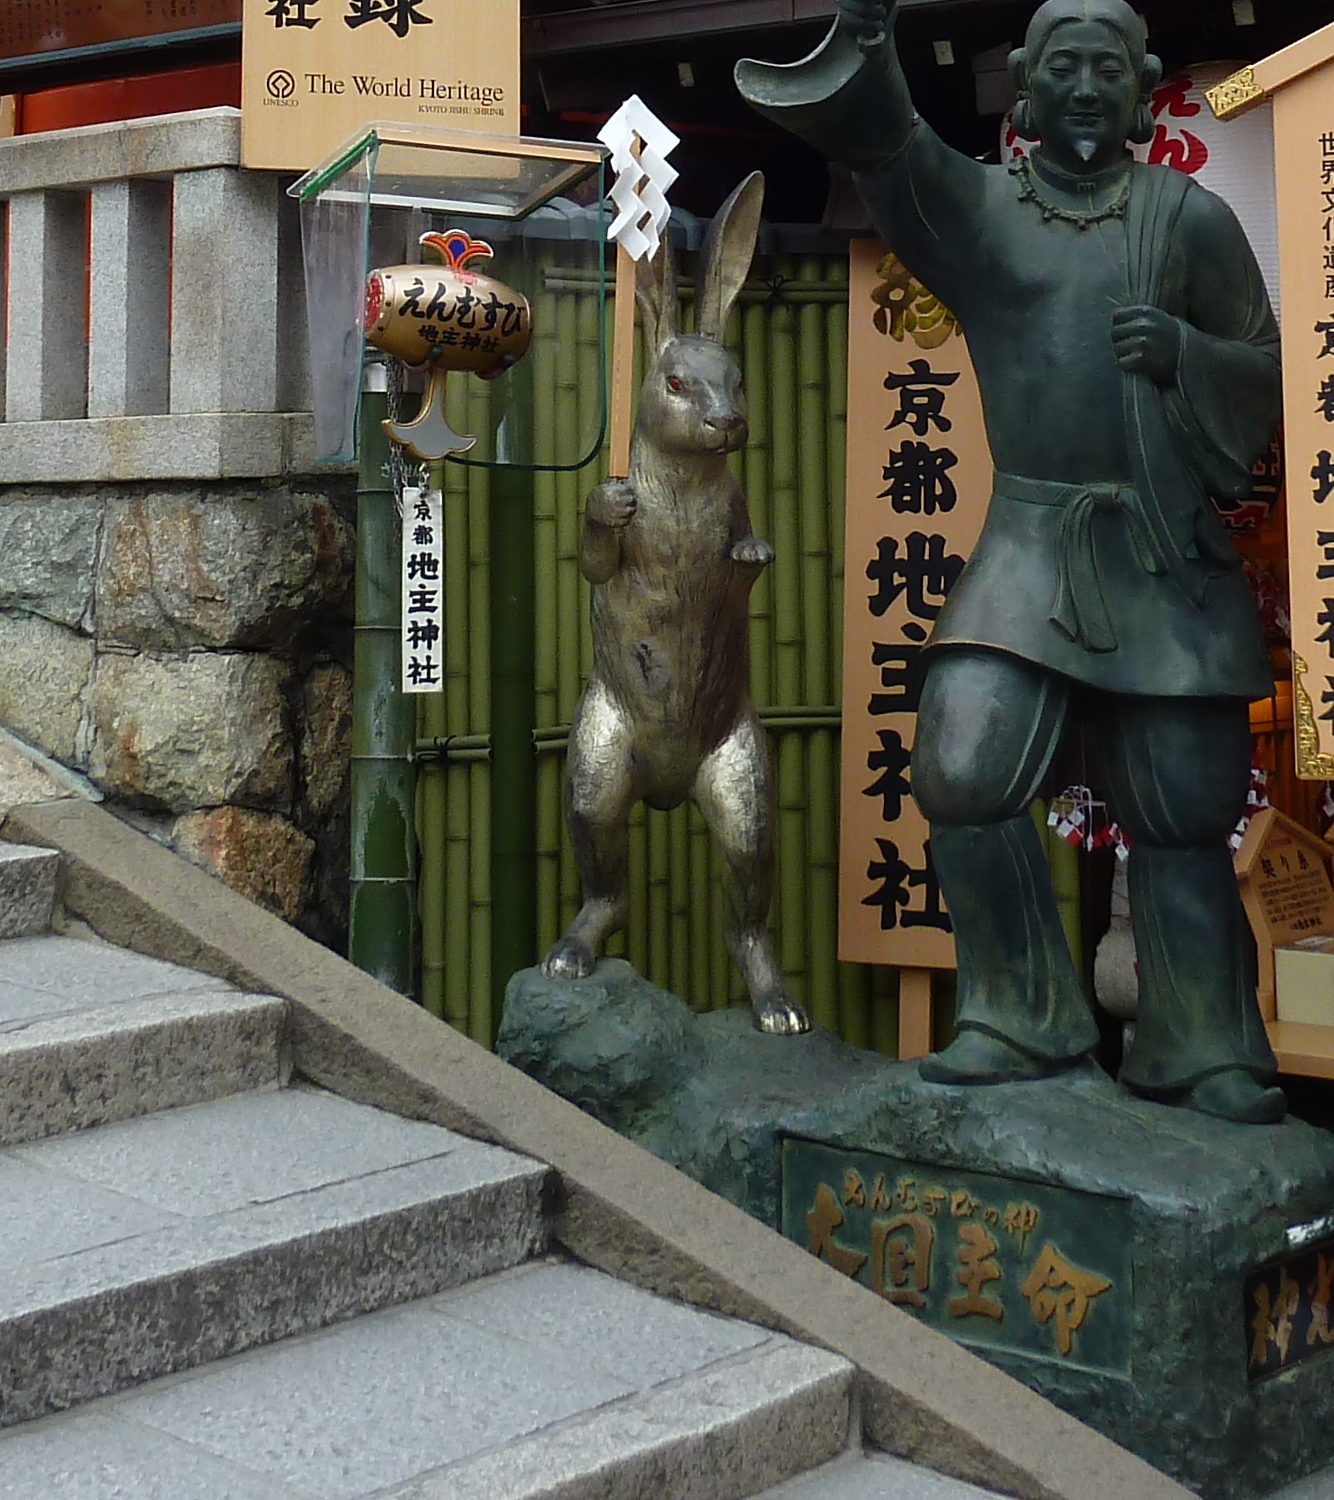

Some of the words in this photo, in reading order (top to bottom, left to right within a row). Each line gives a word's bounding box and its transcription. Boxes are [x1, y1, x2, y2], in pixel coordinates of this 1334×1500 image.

[263, 98, 299, 108] UNESCO
[304, 73, 345, 95] The
[352, 76, 412, 98] World
[419, 79, 504, 106] Heritage
[418, 104, 448, 115] KYOTO
[473, 106, 505, 117] SHRINE
[399, 277, 526, 337] えんむすび
[418, 325, 502, 352] 地主神社
[405, 499, 441, 685] 京都地主神社
